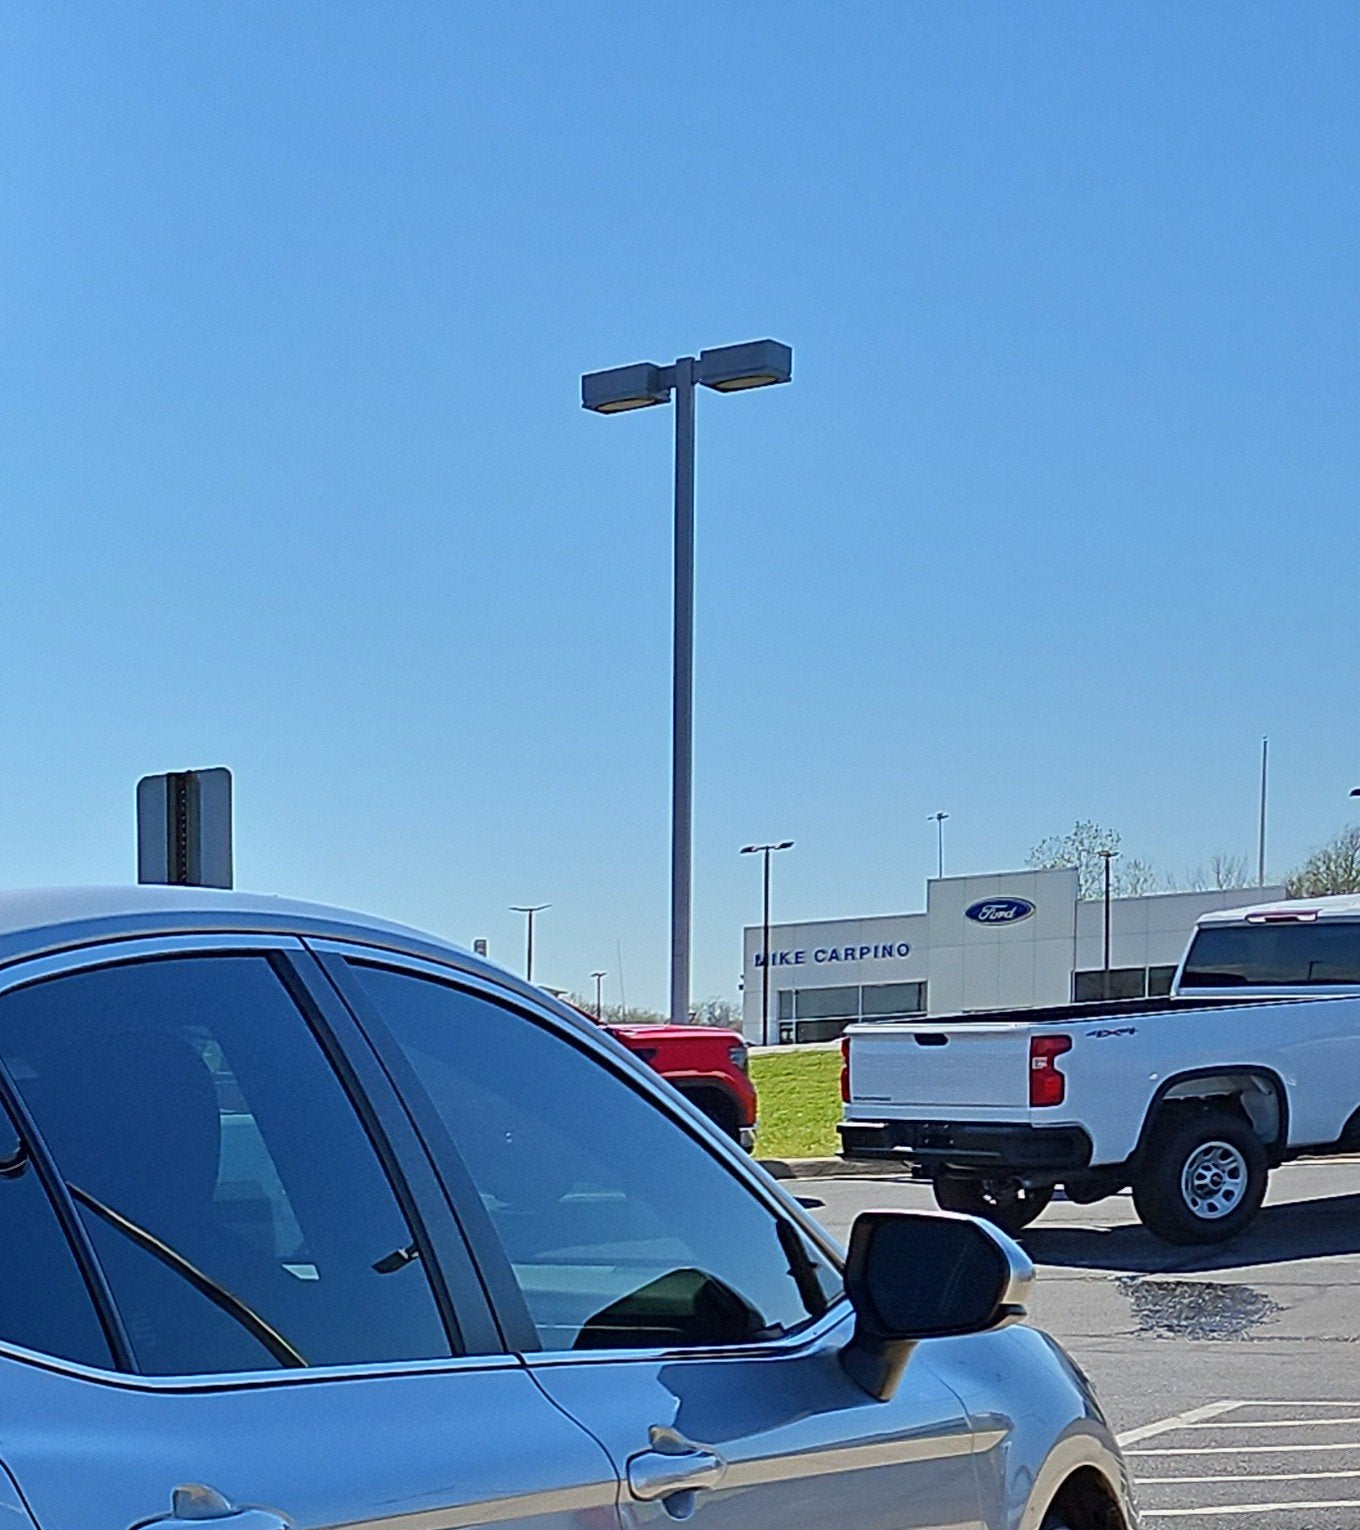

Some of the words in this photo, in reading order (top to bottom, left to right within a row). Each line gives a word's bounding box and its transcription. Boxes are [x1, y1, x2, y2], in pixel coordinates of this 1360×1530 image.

[977, 904, 1018, 921] Ford
[755, 949, 806, 967] MIKE
[813, 943, 911, 964] CARPINO
